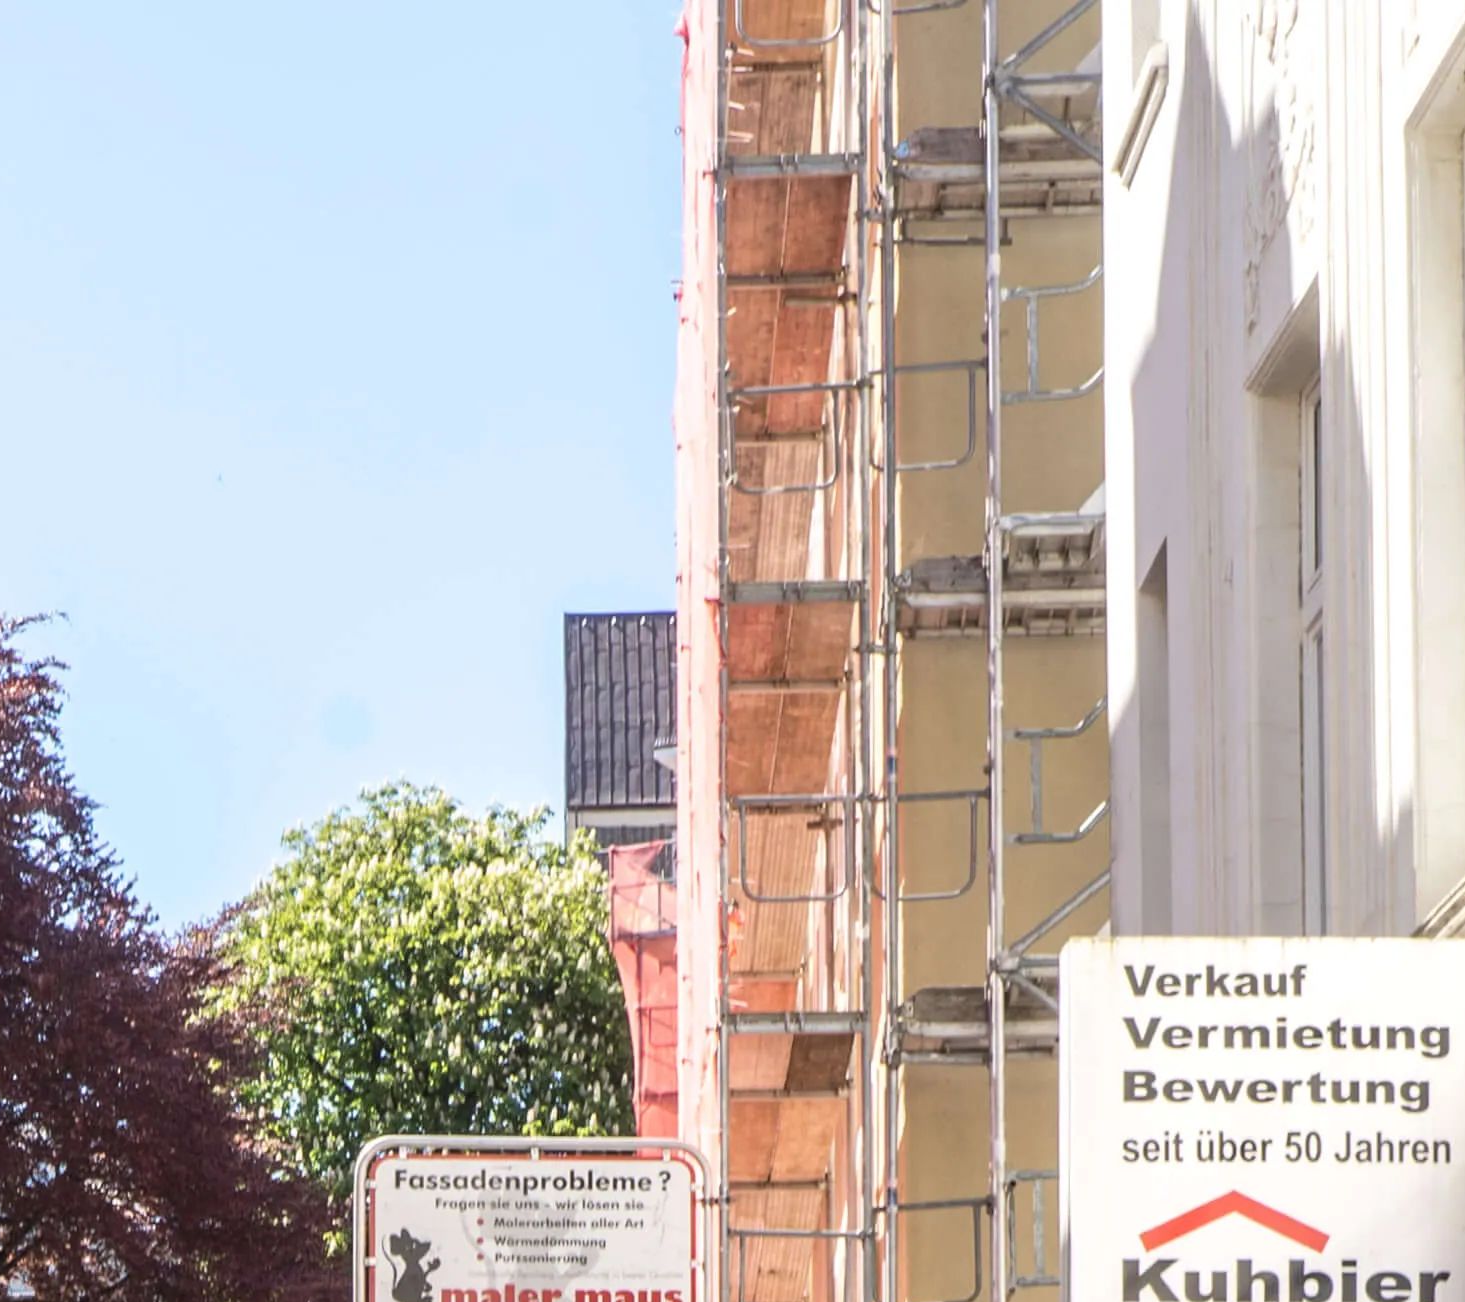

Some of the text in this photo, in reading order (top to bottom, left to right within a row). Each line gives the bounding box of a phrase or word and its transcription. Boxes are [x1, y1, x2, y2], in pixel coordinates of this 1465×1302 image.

[1124, 964, 1307, 997] Verkauf
[1123, 1017, 1451, 1058] Vermietung
[1123, 1070, 1430, 1112] Bewertung
[1123, 1131, 1451, 1163] seit über 50 Jahren
[394, 1169, 652, 1195] Fassadenprobleme
[435, 1198, 486, 1211] Fragen
[490, 1198, 510, 1210] sie
[515, 1200, 539, 1210] uns
[556, 1198, 576, 1210] wir
[582, 1198, 620, 1210] lösen
[493, 1217, 587, 1229] Malerarbeiten
[625, 1217, 645, 1229] Art
[493, 1236, 607, 1249] Wärmedämmung
